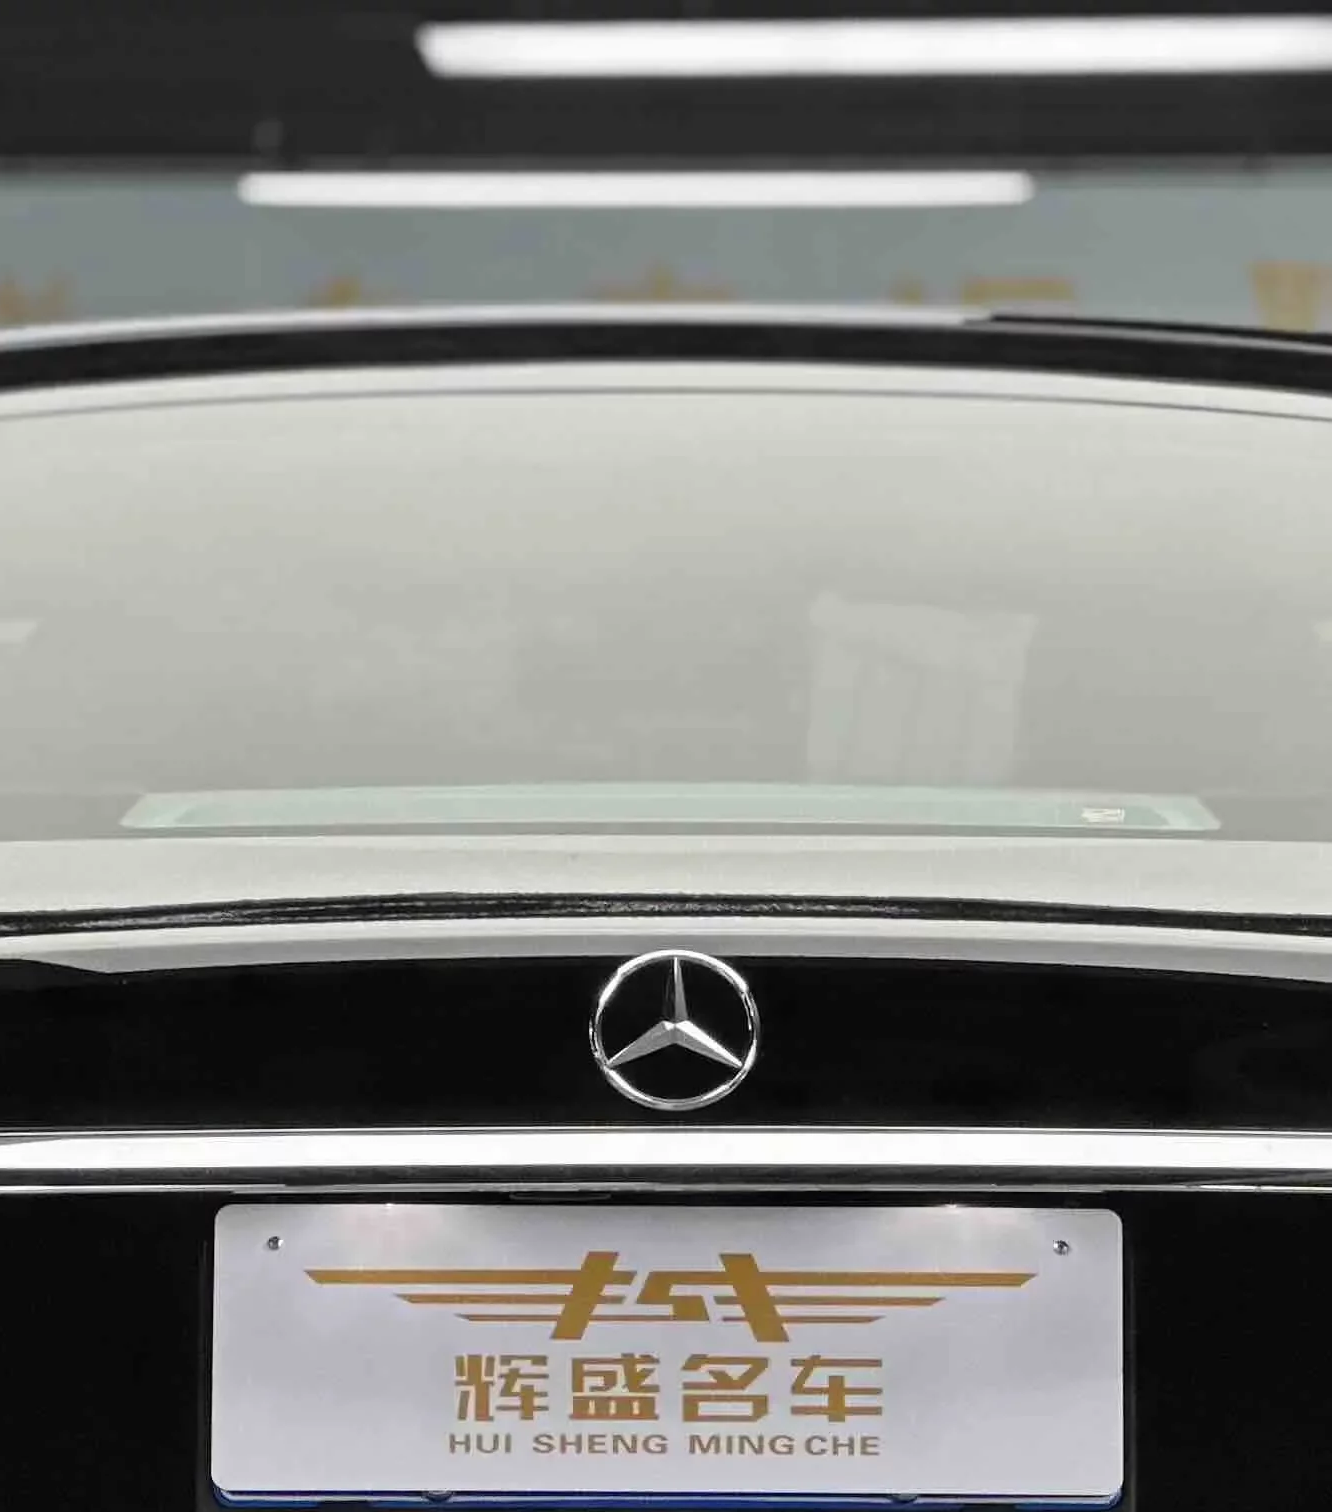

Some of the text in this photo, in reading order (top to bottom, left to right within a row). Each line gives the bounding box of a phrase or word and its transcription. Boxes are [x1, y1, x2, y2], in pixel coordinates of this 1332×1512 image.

[455, 1353, 883, 1422] 辉盛名车
[449, 1434, 512, 1455] HUI
[532, 1434, 668, 1455] SHENG
